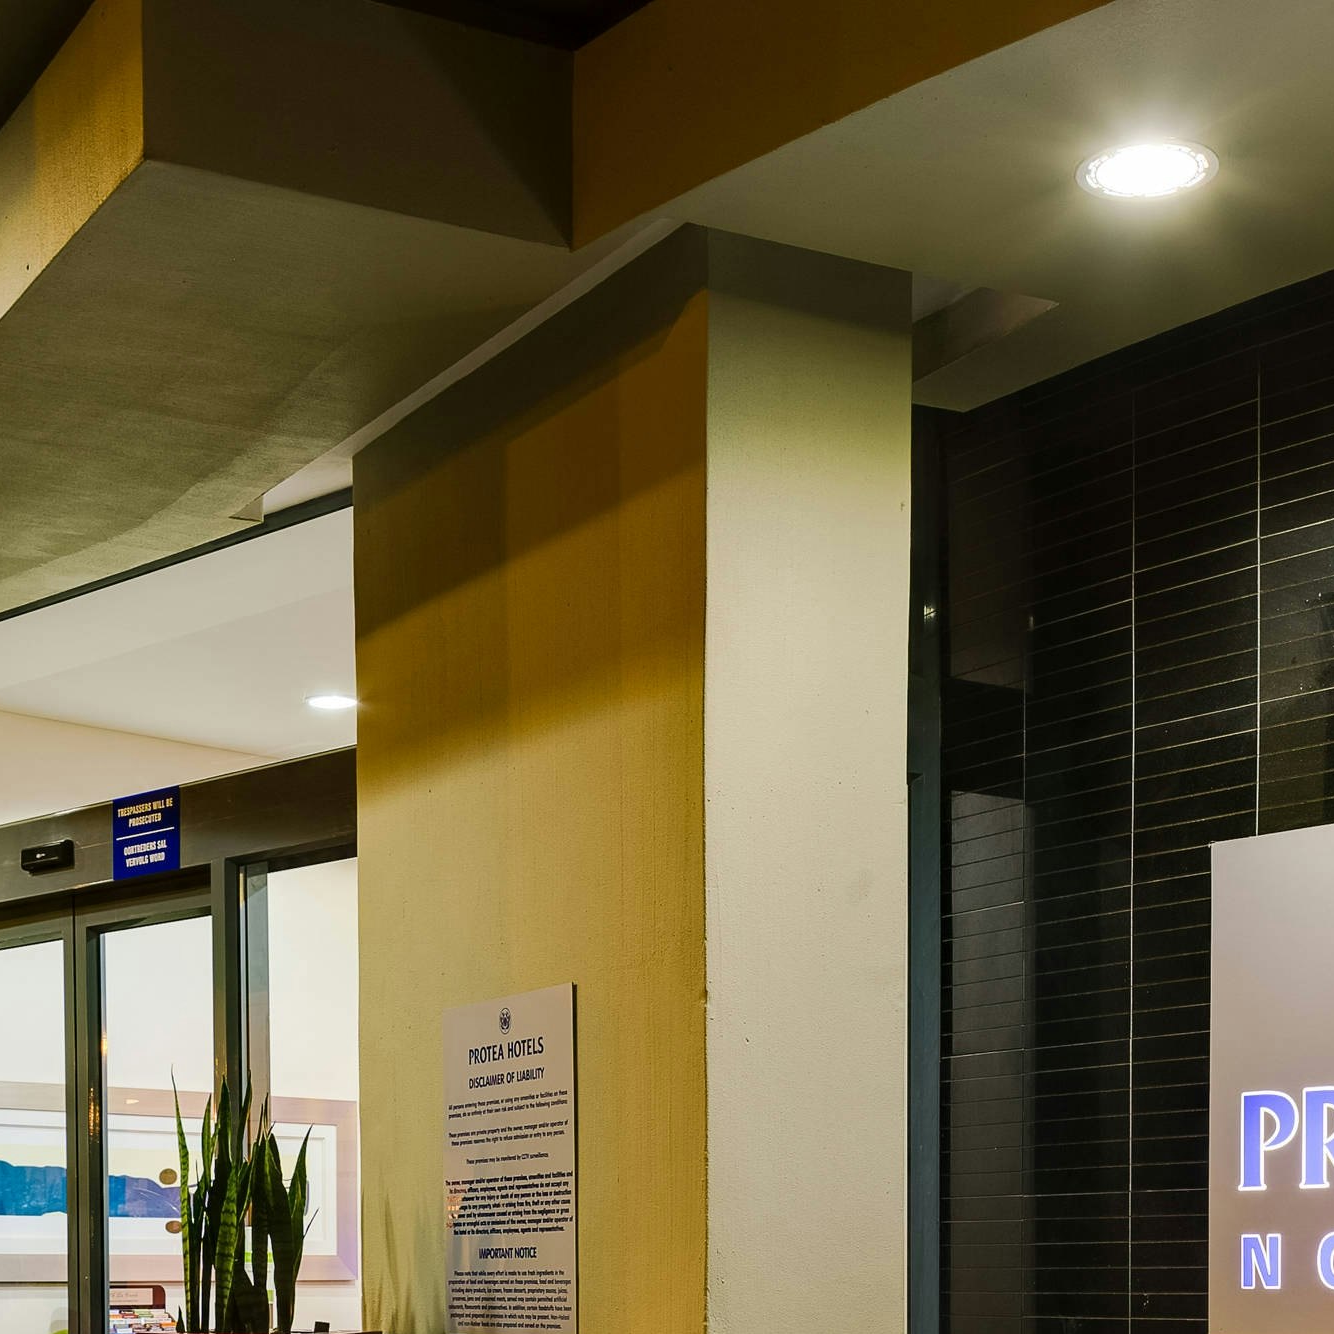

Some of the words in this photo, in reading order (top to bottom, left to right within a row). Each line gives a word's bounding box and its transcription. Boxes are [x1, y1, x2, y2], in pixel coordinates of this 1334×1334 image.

[118, 803, 151, 817] TRESPASSERS
[152, 800, 165, 810] WILL
[166, 798, 173, 807] BE
[129, 813, 161, 827] PROSECUTED
[157, 840, 167, 849] SAL
[469, 1044, 504, 1065] PROTEA
[508, 1037, 544, 1059] HOTELS
[469, 1074, 505, 1089] DISCLAIMER
[506, 1072, 515, 1083] OF
[517, 1067, 545, 1082] LIABILITY
[479, 1248, 513, 1259] IMPORTANT
[514, 1247, 537, 1258] NOTICE
